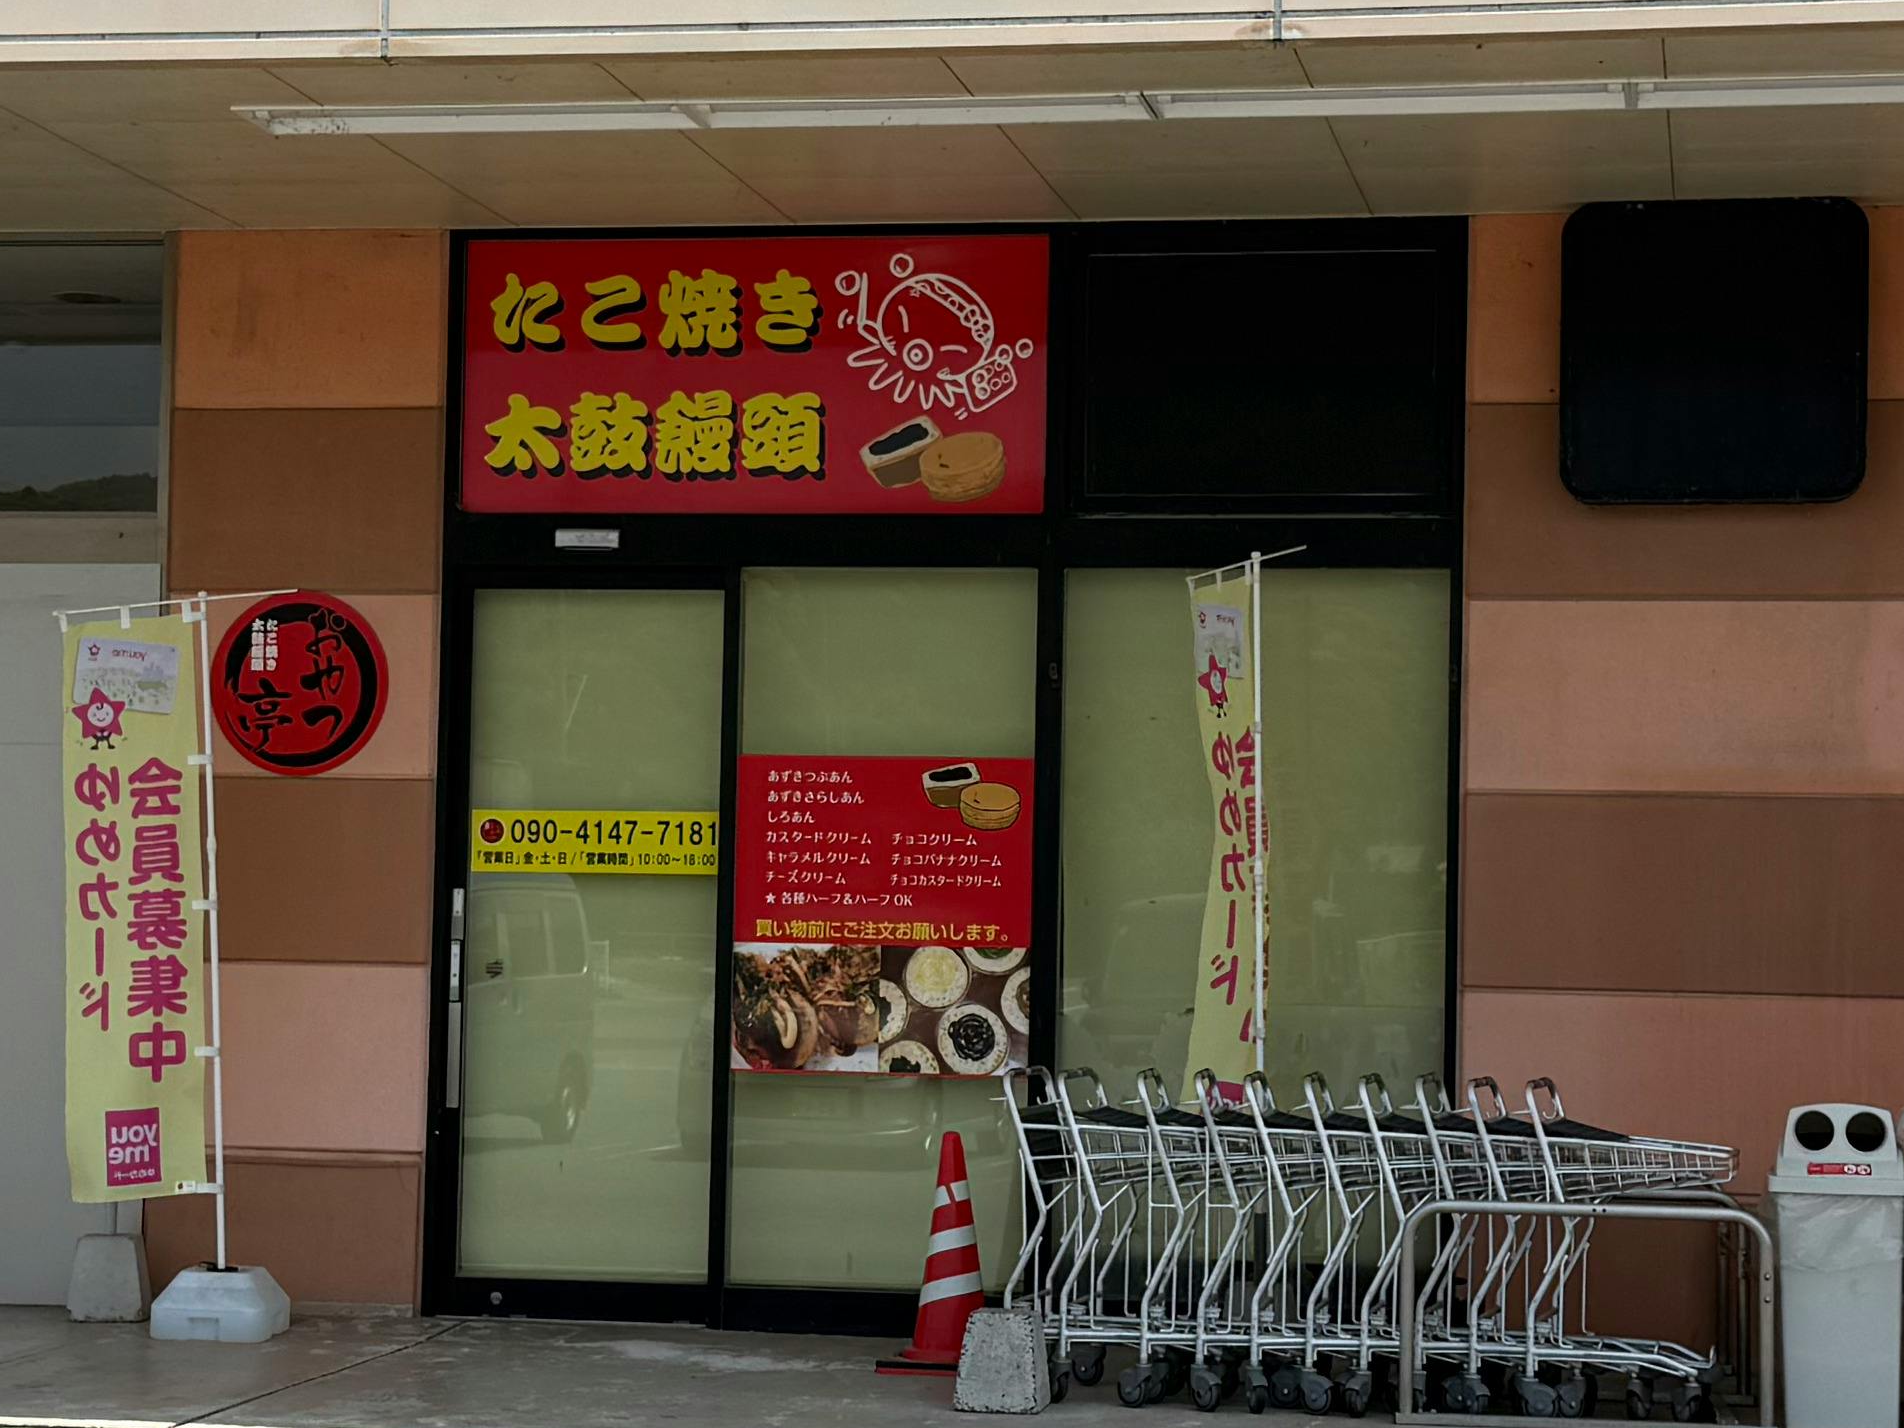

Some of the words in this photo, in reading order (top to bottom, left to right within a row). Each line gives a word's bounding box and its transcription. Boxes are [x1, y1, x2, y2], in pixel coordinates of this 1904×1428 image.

[491, 268, 822, 352] たこ焼き
[484, 390, 823, 475] 太鼓饅頭
[768, 770, 853, 784] あずきつぶあん
[767, 790, 865, 804] あずきさらしあん
[767, 810, 815, 823] しろあん
[511, 819, 718, 845] 090-4147-7181
[766, 831, 872, 844] カスタードクリーム
[891, 832, 977, 846] チョコクリーム
[766, 851, 871, 864] キャラメルクリーム
[891, 853, 1002, 867] チョコバナナクリーム
[765, 870, 846, 884] チーズクリーム
[890, 873, 1002, 887] チョコカスタードクリーム
[894, 894, 913, 906] OK
[756, 918, 1008, 942] 買い物前にご注文お願いします。
